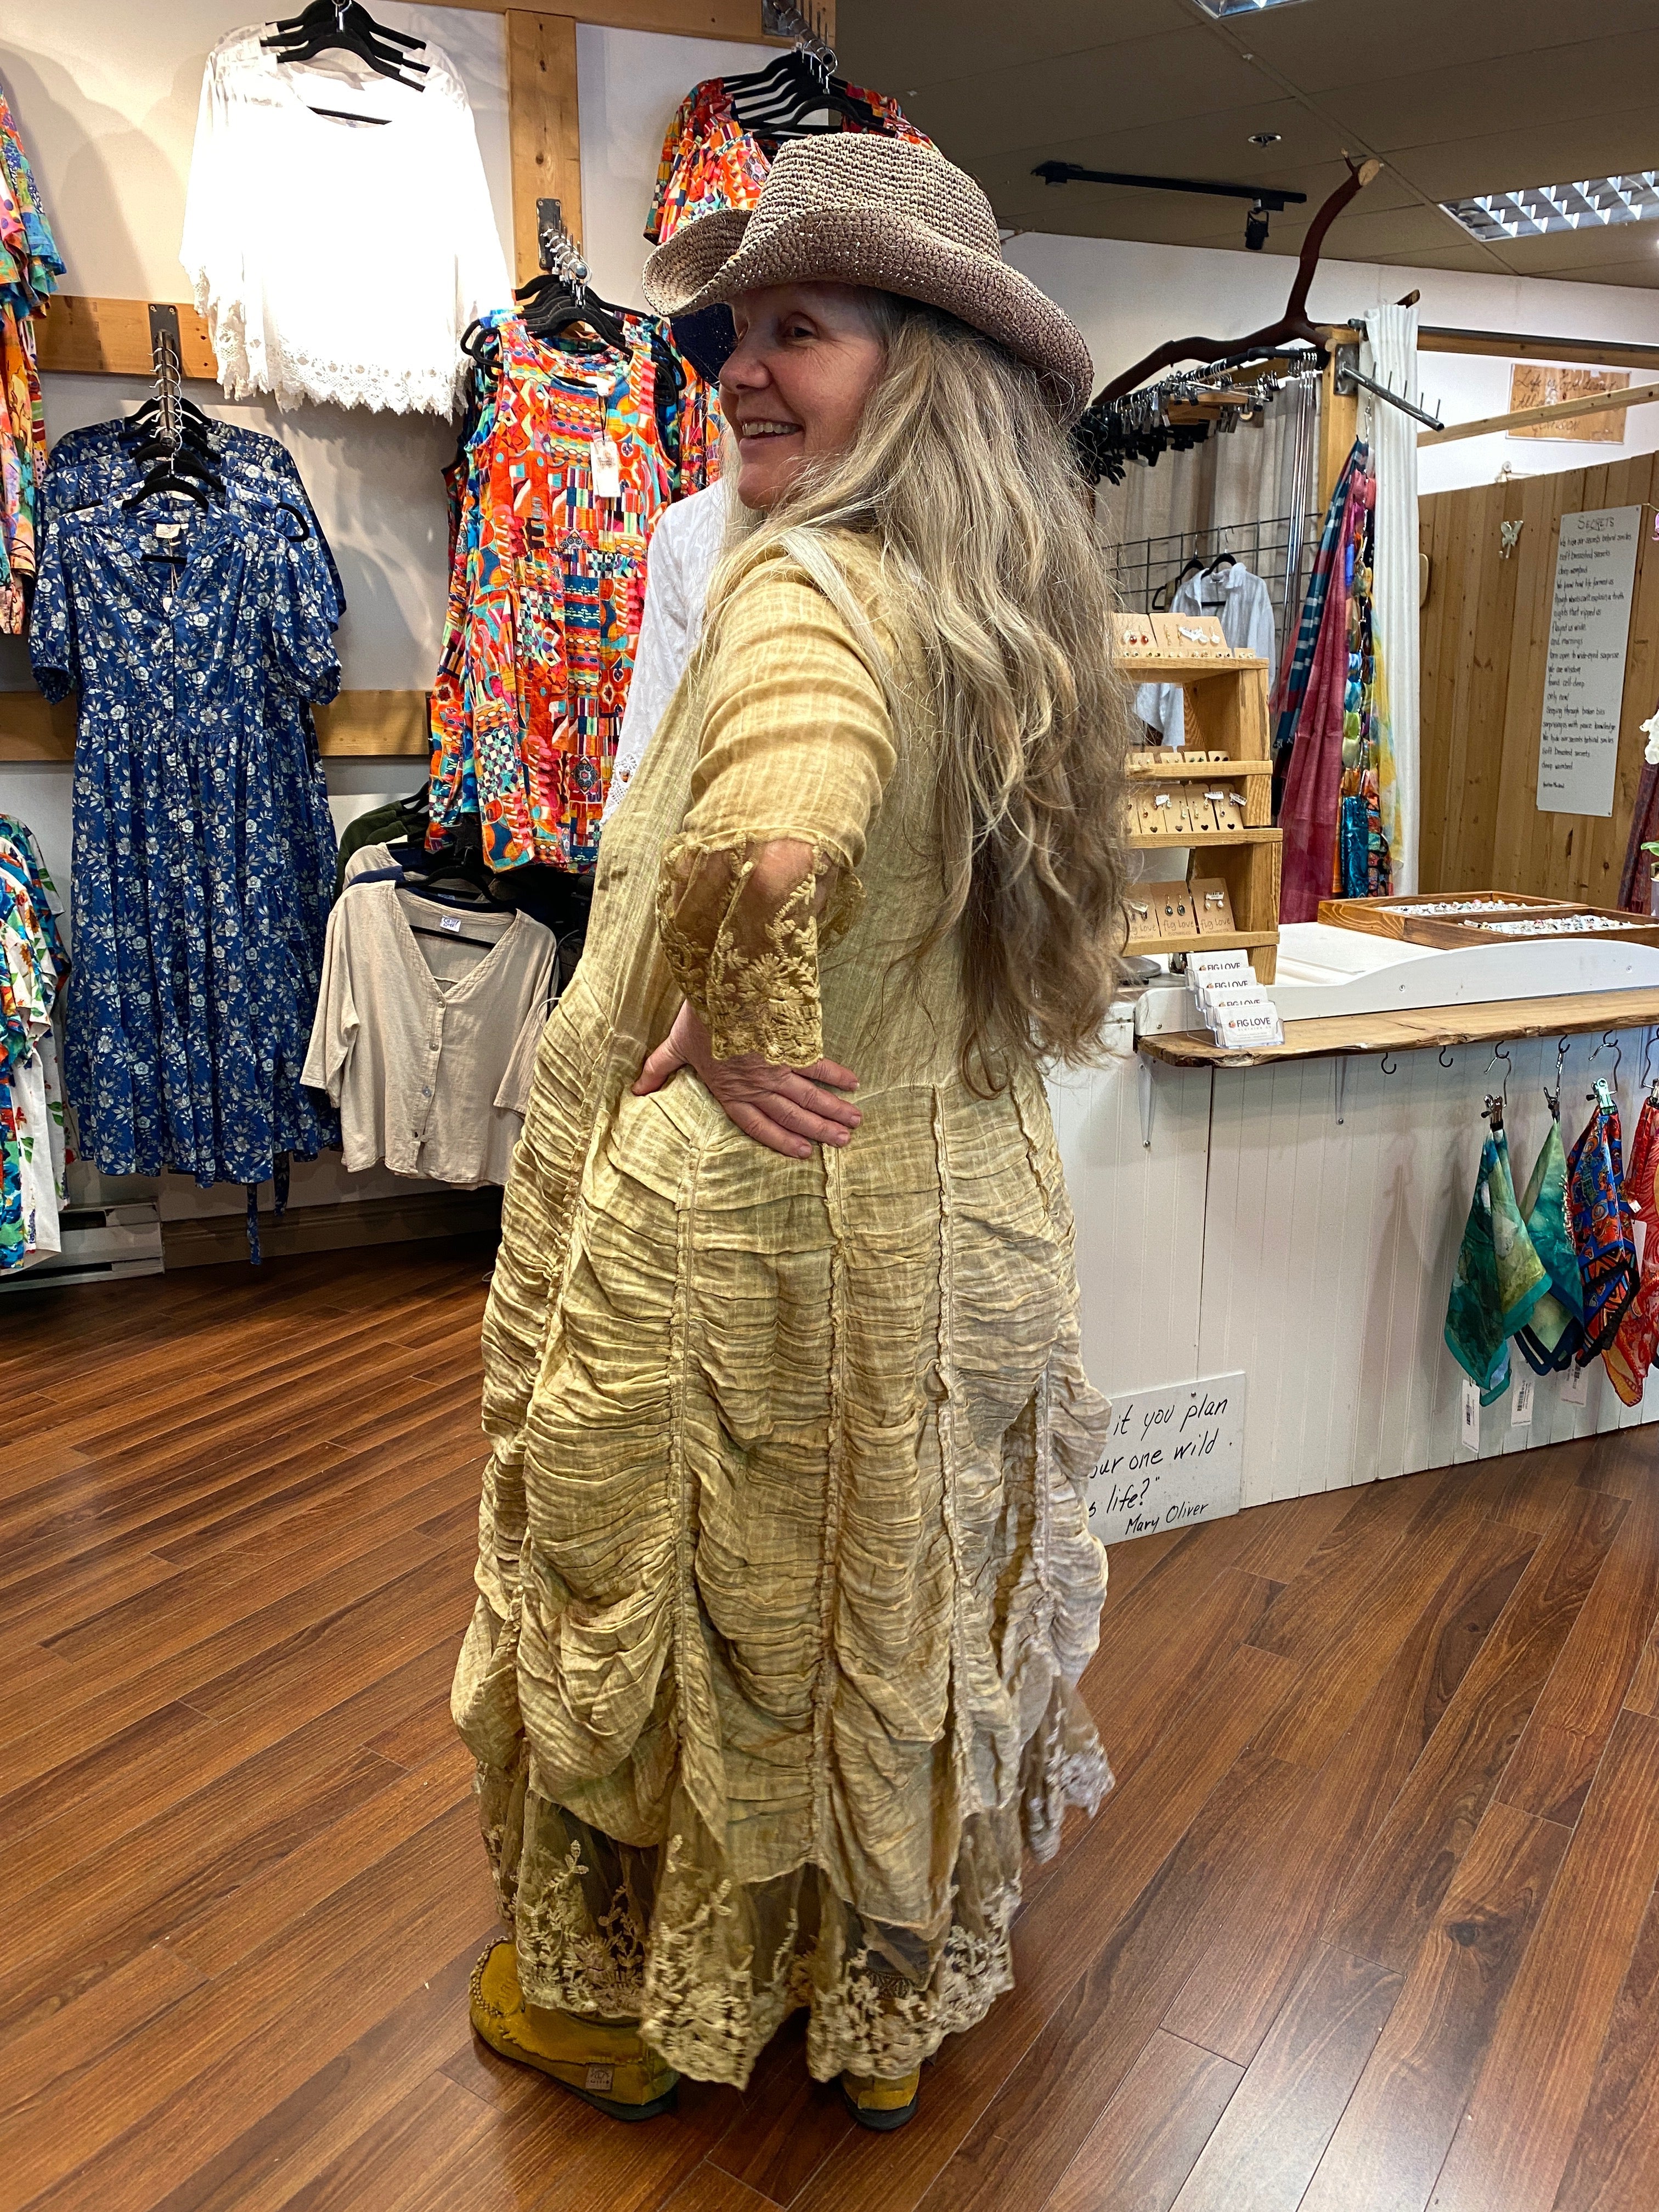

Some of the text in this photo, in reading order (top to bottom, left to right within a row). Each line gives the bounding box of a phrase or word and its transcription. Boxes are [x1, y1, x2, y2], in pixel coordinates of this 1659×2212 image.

[1578, 515, 1614, 531] SECRETS
[1163, 919, 1194, 931] fig love
[1200, 917, 1231, 931] fig love
[1250, 1017, 1271, 1026] LOVE
[1113, 1393, 1228, 1442] it you plan
[1089, 1427, 1219, 1479] our one wild
[1125, 1501, 1209, 1535] Mary Oliver
